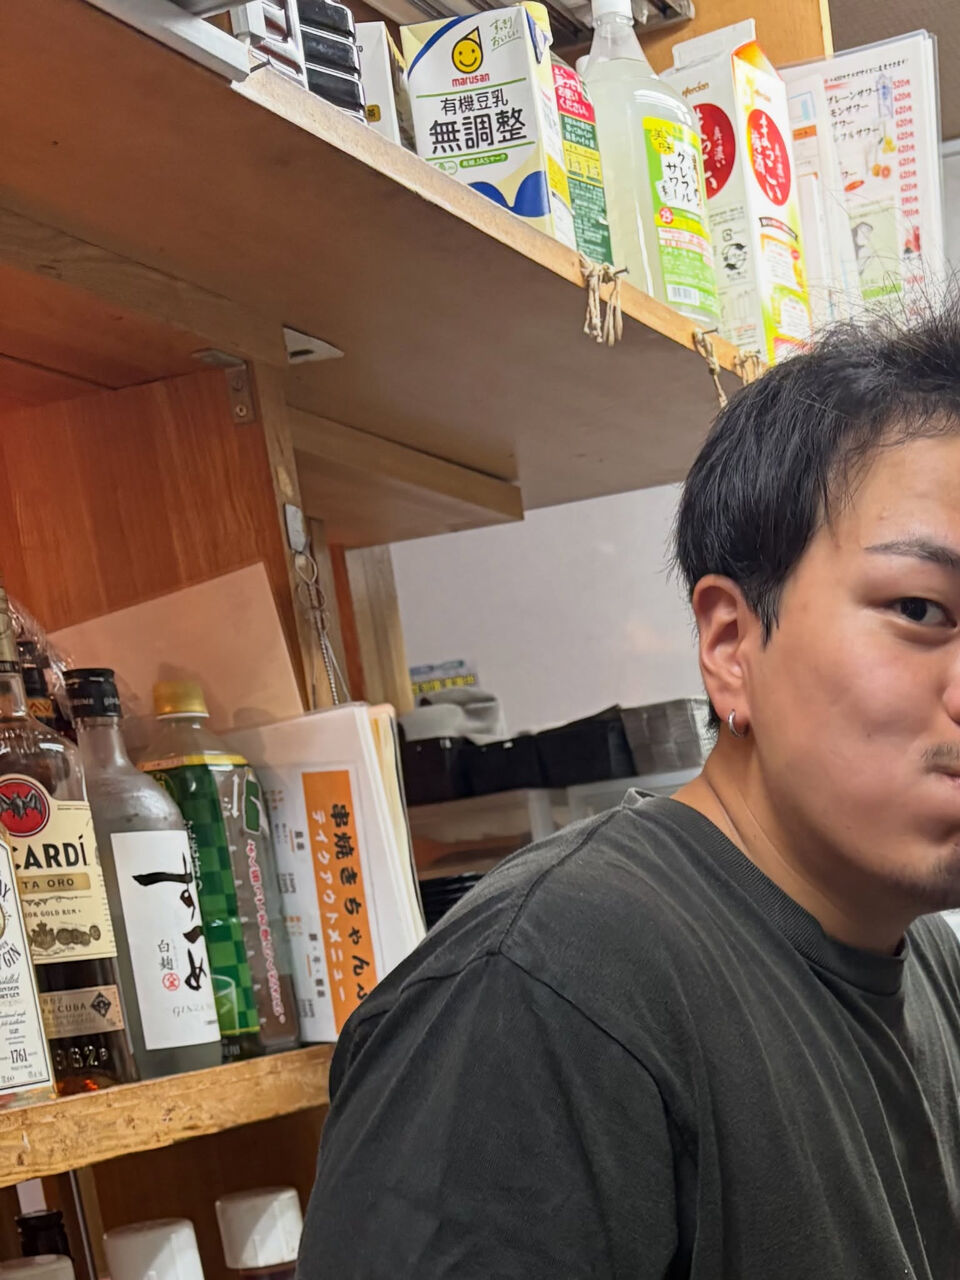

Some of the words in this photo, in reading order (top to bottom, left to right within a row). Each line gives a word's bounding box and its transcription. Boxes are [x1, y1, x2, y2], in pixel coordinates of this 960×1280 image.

[452, 73, 490, 87] marusan
[440, 88, 508, 116] 有機豆乳
[429, 107, 527, 154] 無調整
[12, 834, 89, 871] ARDÍ
[47, 878, 74, 888] ORO
[312, 809, 346, 1003] テイクアウトメニュー
[57, 1002, 87, 1013] CUBA
[10, 1048, 27, 1064] 1761
